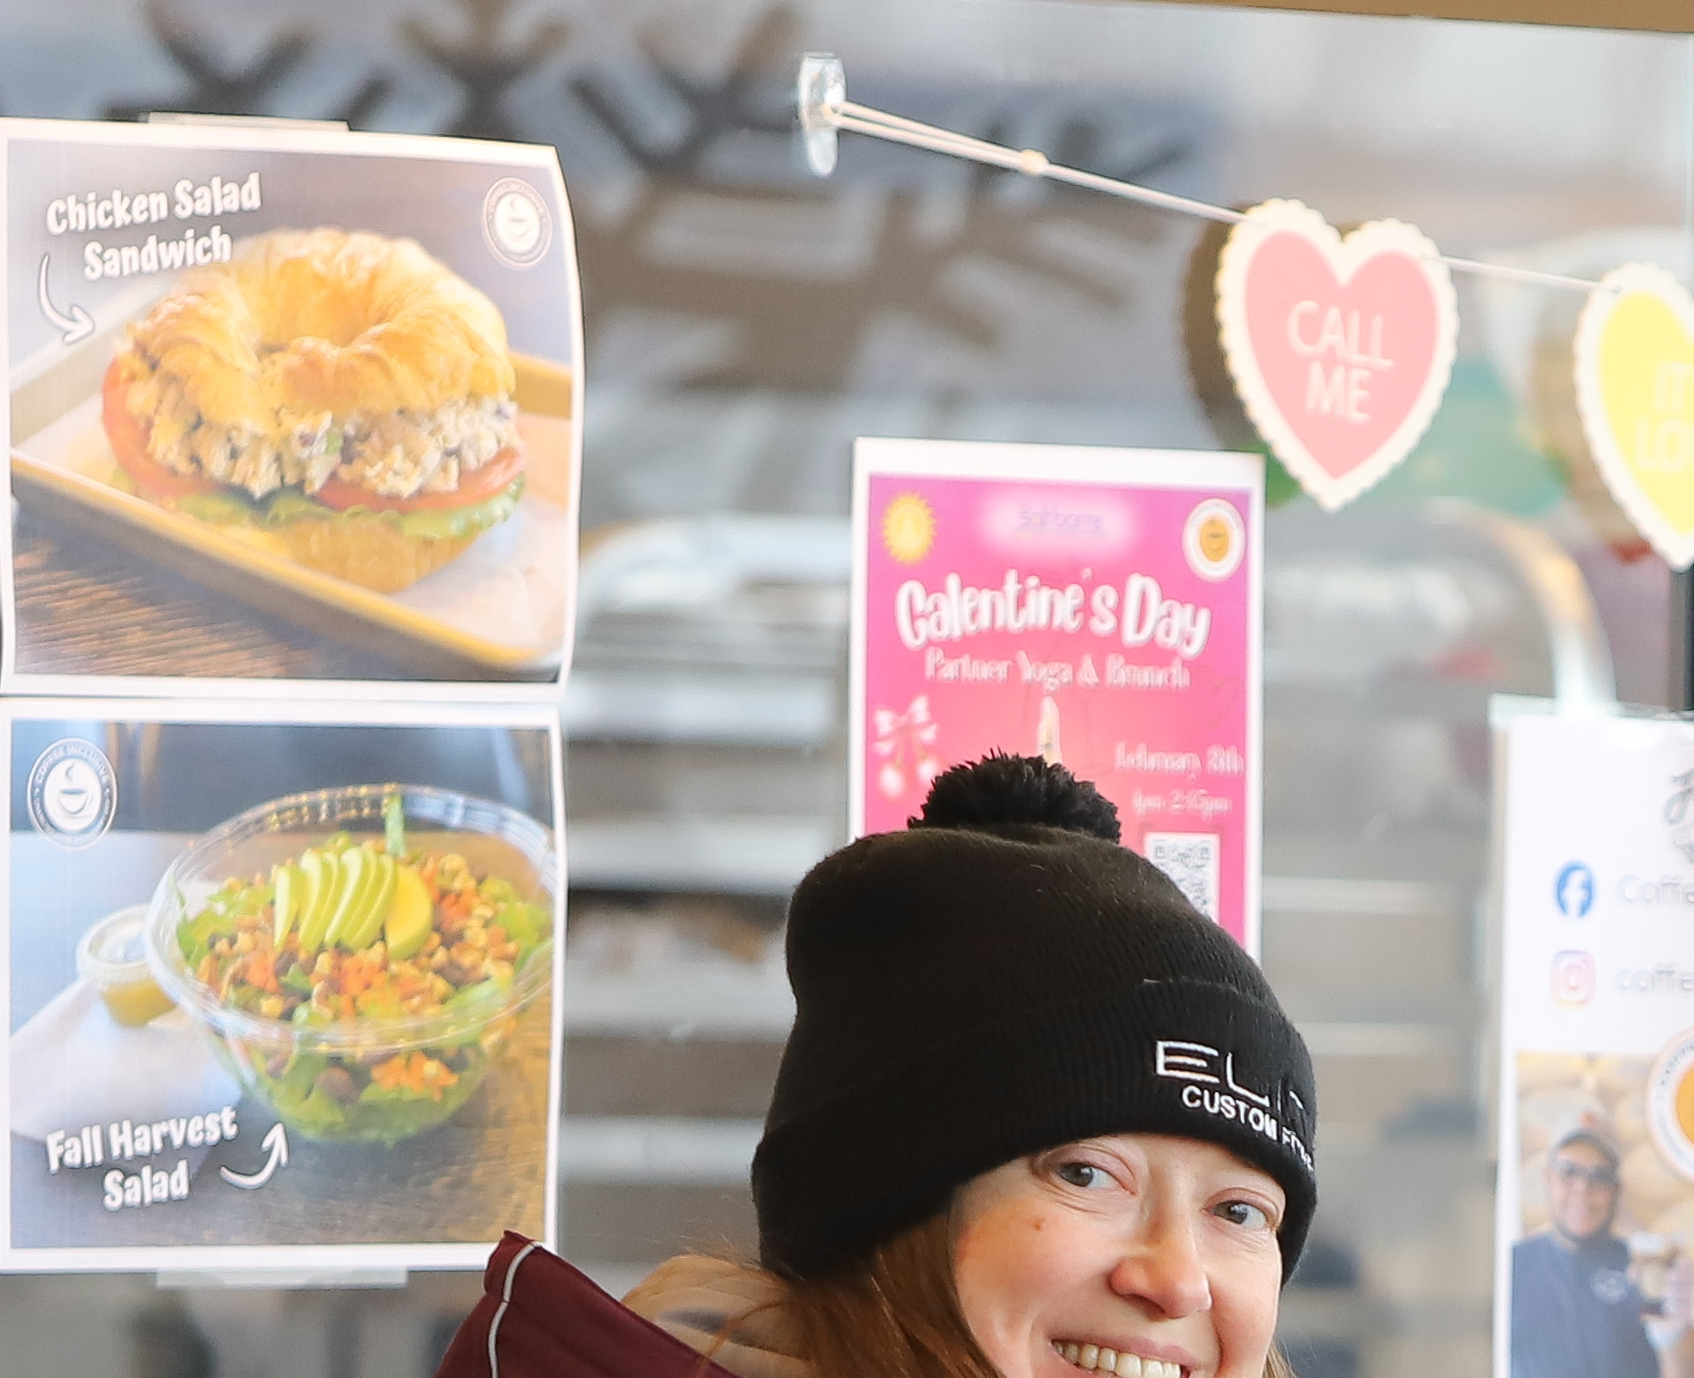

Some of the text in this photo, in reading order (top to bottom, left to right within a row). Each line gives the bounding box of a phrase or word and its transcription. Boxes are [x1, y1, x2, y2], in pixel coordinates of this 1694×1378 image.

[46, 171, 263, 236] Chicken Salad
[83, 226, 232, 280] Sandwich
[1286, 299, 1395, 371] CALL
[1305, 360, 1373, 425] ME
[1121, 571, 1213, 659] Day
[46, 1104, 239, 1174] Fall Harvest
[1181, 1085, 1278, 1142] CUSTOM
[102, 1160, 190, 1212] Salad
